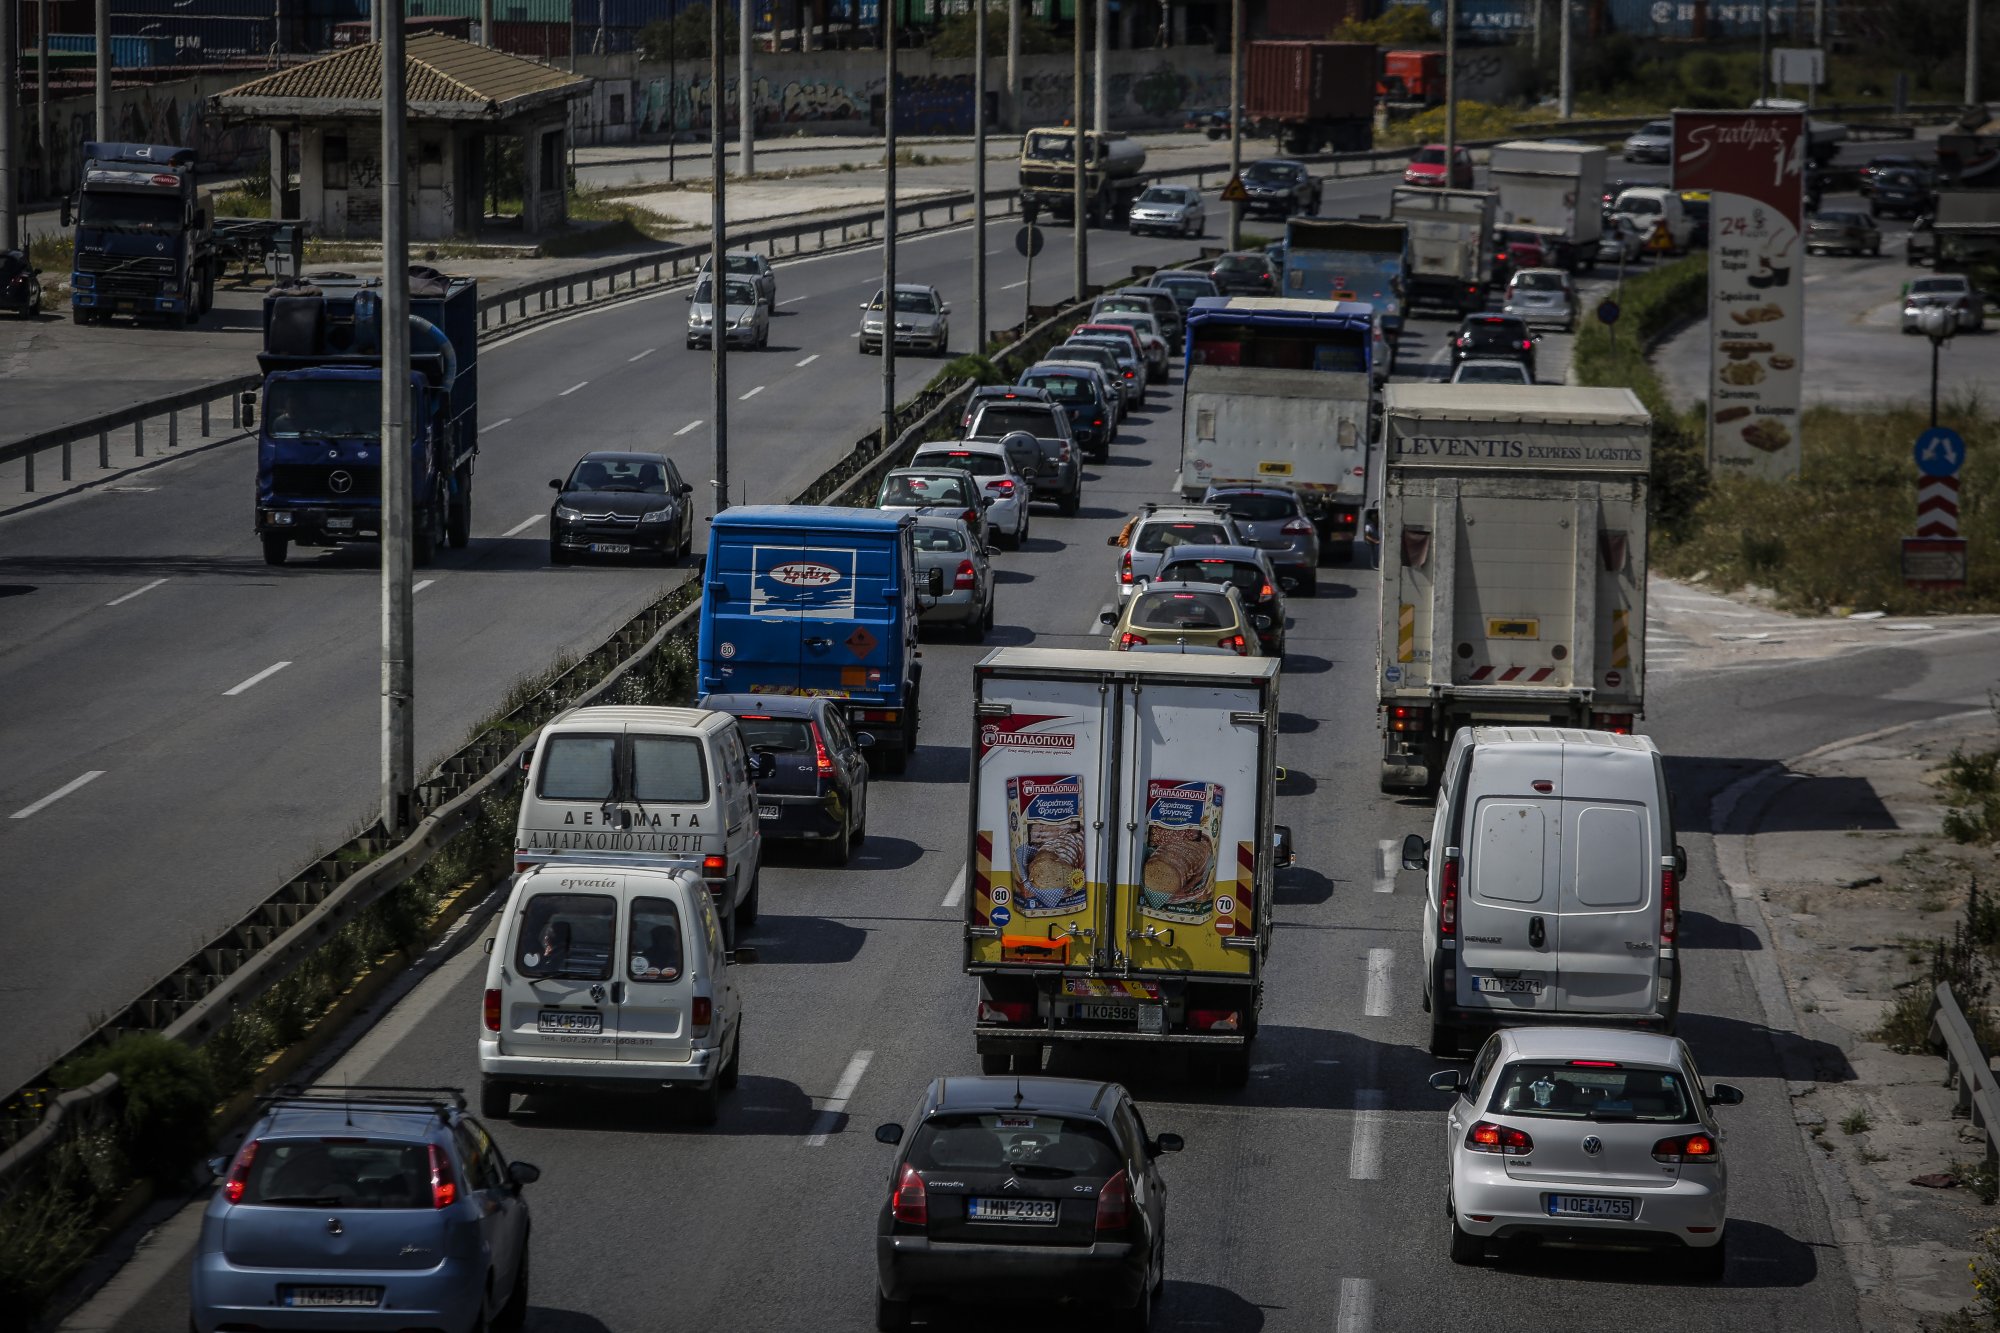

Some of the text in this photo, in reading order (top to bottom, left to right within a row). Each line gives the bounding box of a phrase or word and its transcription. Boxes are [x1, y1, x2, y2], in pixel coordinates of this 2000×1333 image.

[1395, 437, 1642, 461] LEVENTIS EXPRESS LOGISTICS
[723, 646, 732, 654] 80
[563, 811, 700, 827] ΔΕΡΜΑΤΑ
[560, 877, 616, 890] εγνατία
[995, 891, 1007, 901] 80
[1219, 900, 1231, 910] 70
